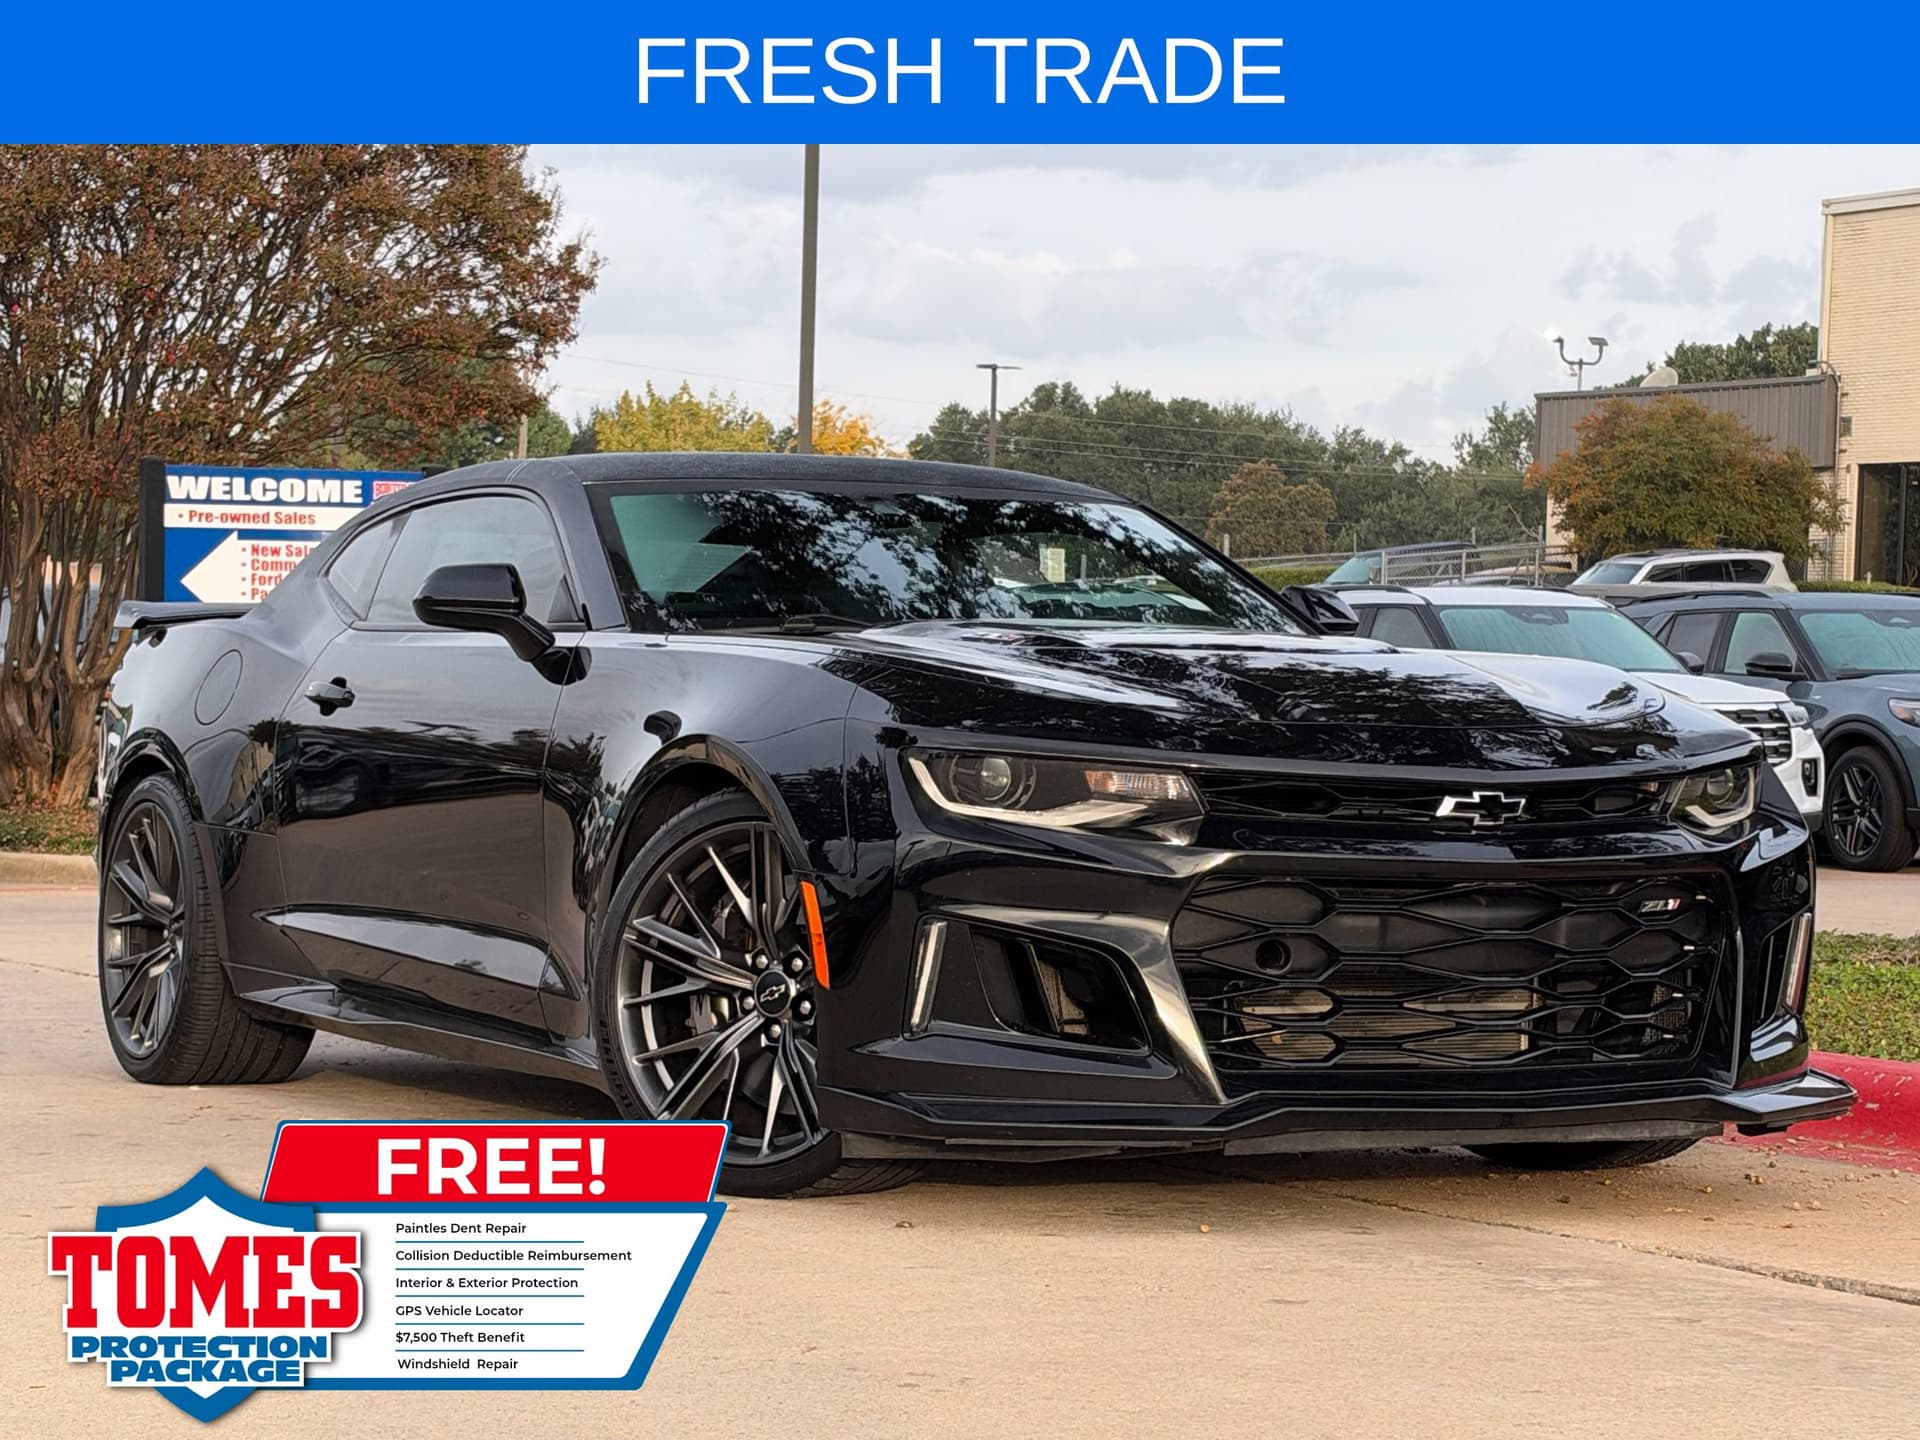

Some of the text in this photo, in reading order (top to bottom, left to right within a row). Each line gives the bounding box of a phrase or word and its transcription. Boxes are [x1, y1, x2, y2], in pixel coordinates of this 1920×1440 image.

[166, 475, 363, 503] WELCOME
[188, 510, 316, 525] Pre-owned Sales
[251, 544, 316, 557] New Sal
